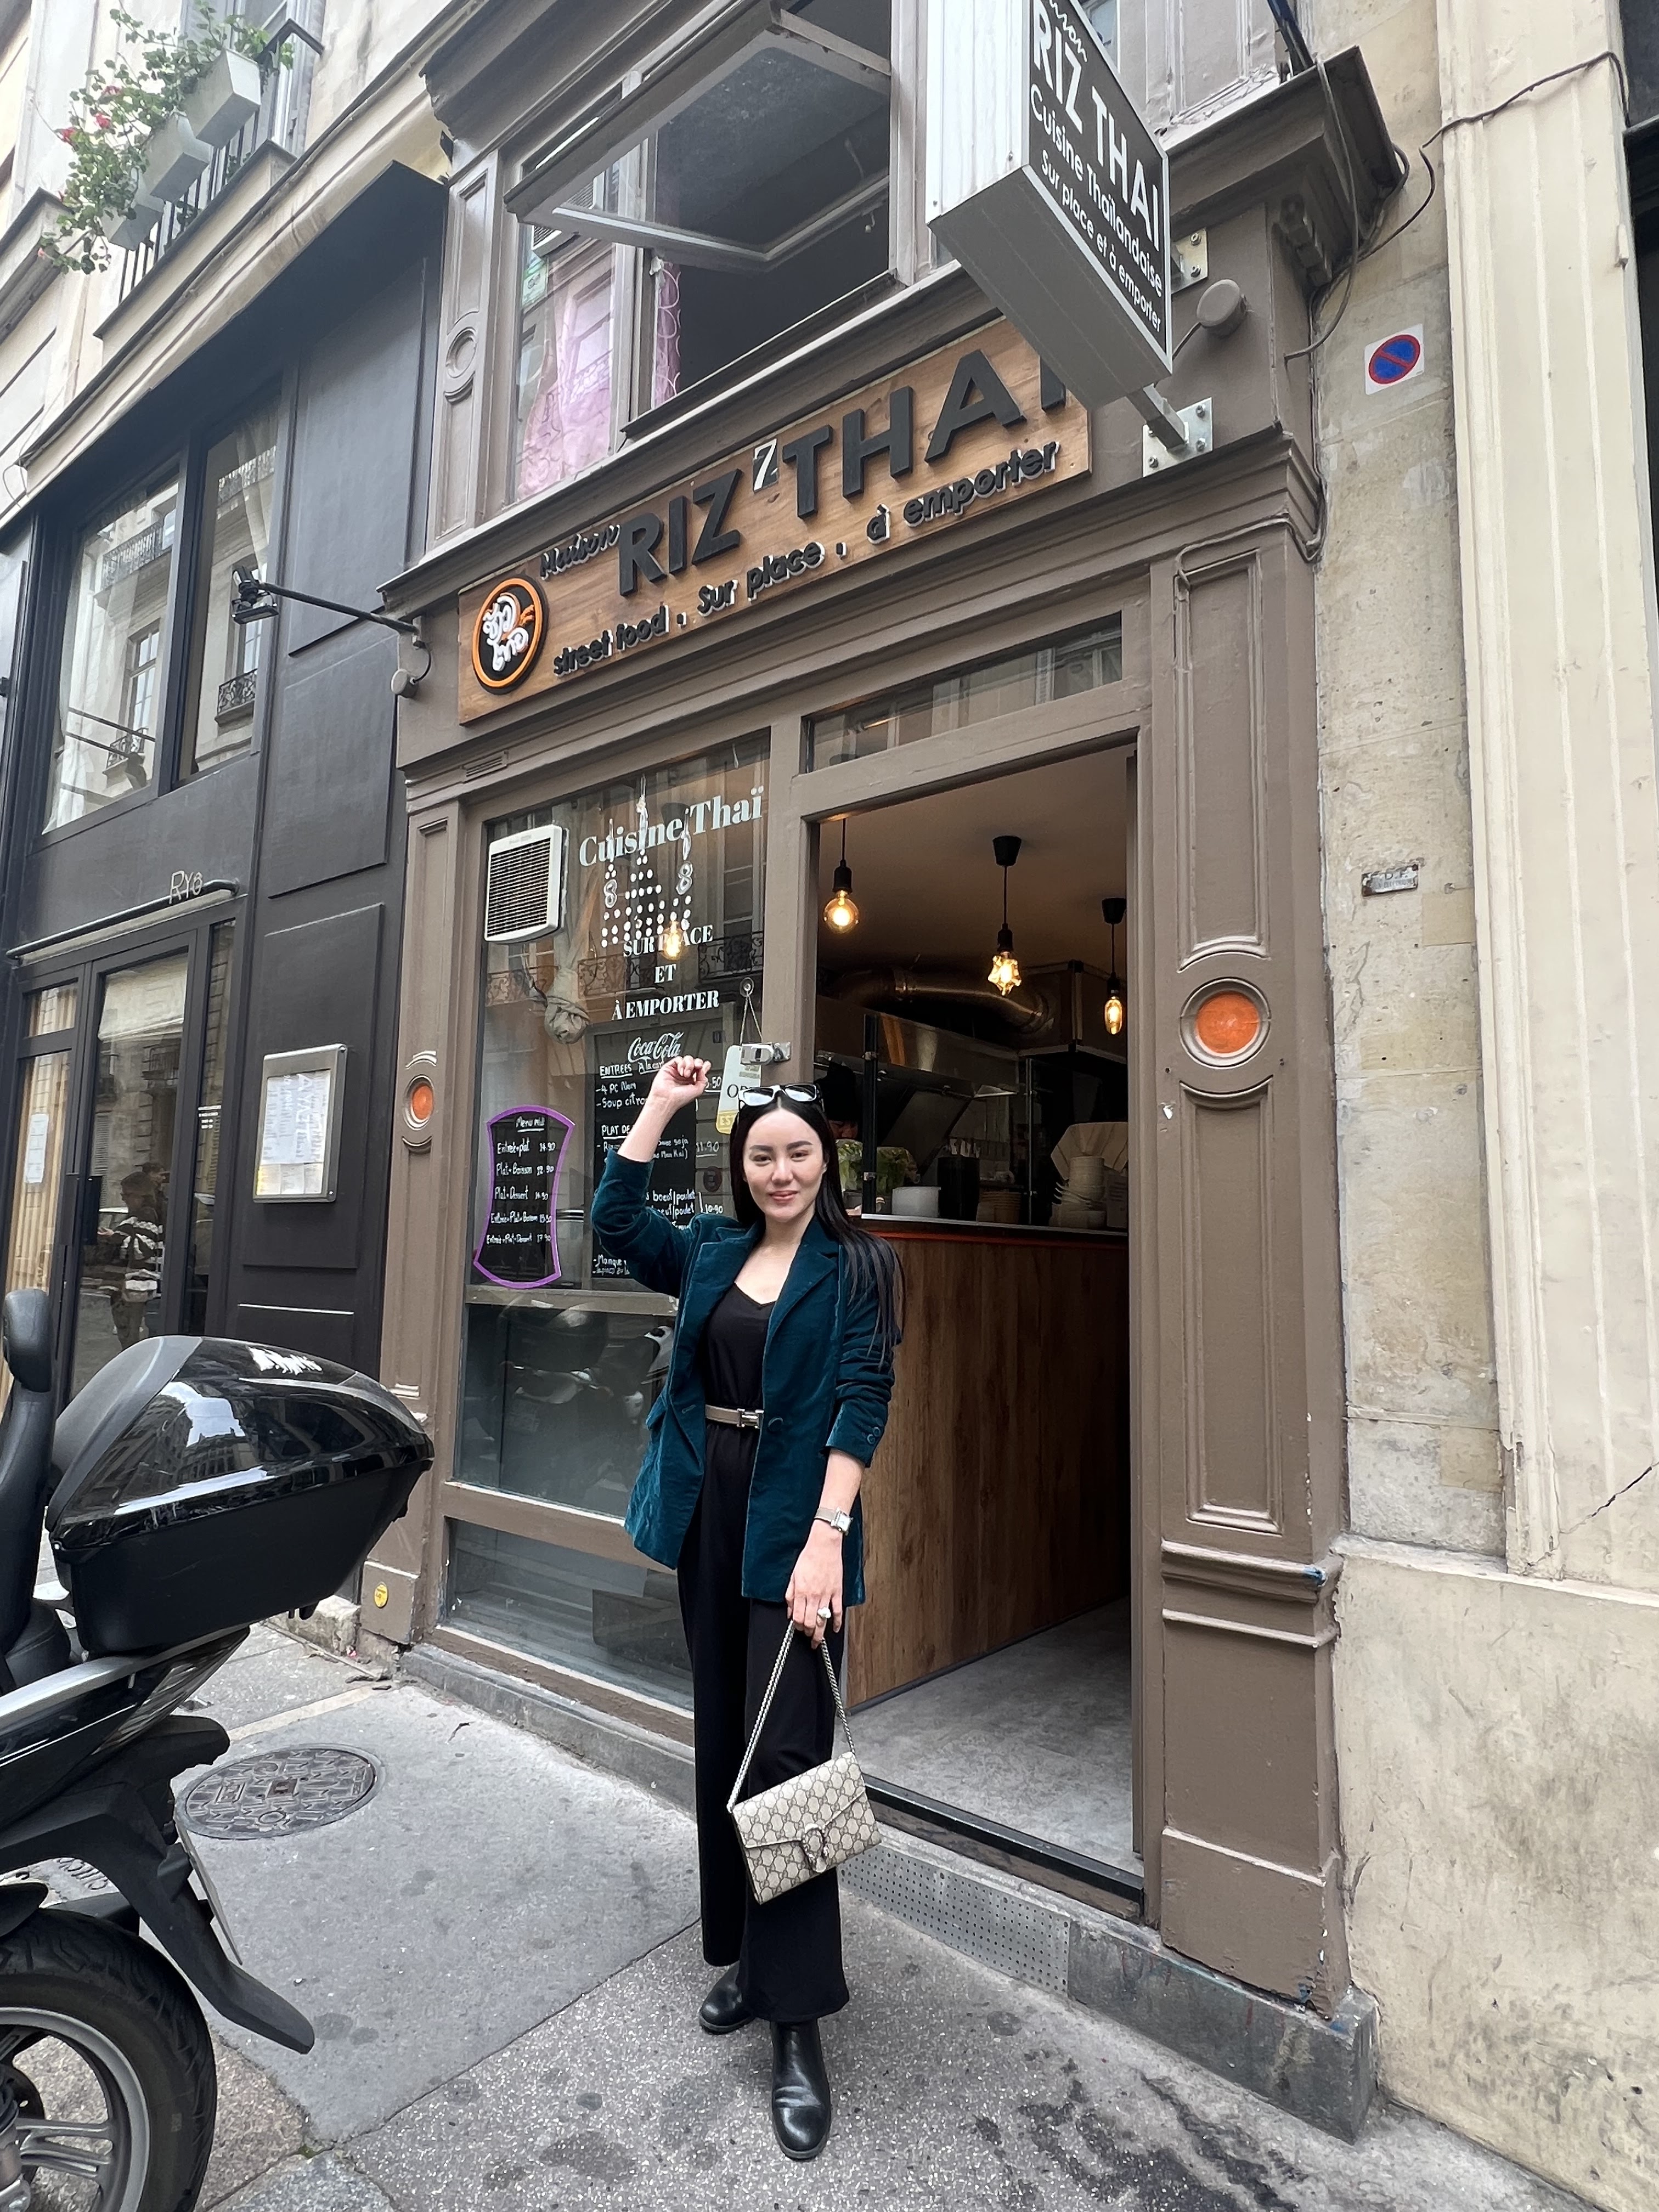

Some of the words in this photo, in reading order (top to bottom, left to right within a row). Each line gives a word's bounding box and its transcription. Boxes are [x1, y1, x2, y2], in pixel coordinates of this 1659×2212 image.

[1034, 0, 1083, 135] RIZ
[1092, 86, 1160, 252] THAI
[1031, 83, 1084, 181] Cuisine
[1086, 163, 1163, 297] Thaïlandaise
[1041, 149, 1060, 190] Sur
[1062, 183, 1094, 239] place
[1096, 233, 1108, 258] et
[1109, 244, 1117, 272] à
[1118, 263, 1161, 332] emporter
[553, 630, 613, 678] street
[616, 605, 670, 651] food
[697, 579, 738, 617] Sur
[747, 541, 825, 602] place
[866, 504, 890, 545] à
[903, 441, 1060, 527] emporter
[619, 469, 742, 597] RIZ
[579, 817, 684, 867] Cuisine
[689, 785, 764, 836] Thaï
[623, 936, 655, 957] SUR
[657, 924, 713, 952] PACE
[654, 964, 676, 984] ET
[611, 1000, 623, 1020] À
[625, 990, 720, 1020] EMPORTER
[601, 1125, 619, 1136] PLAT
